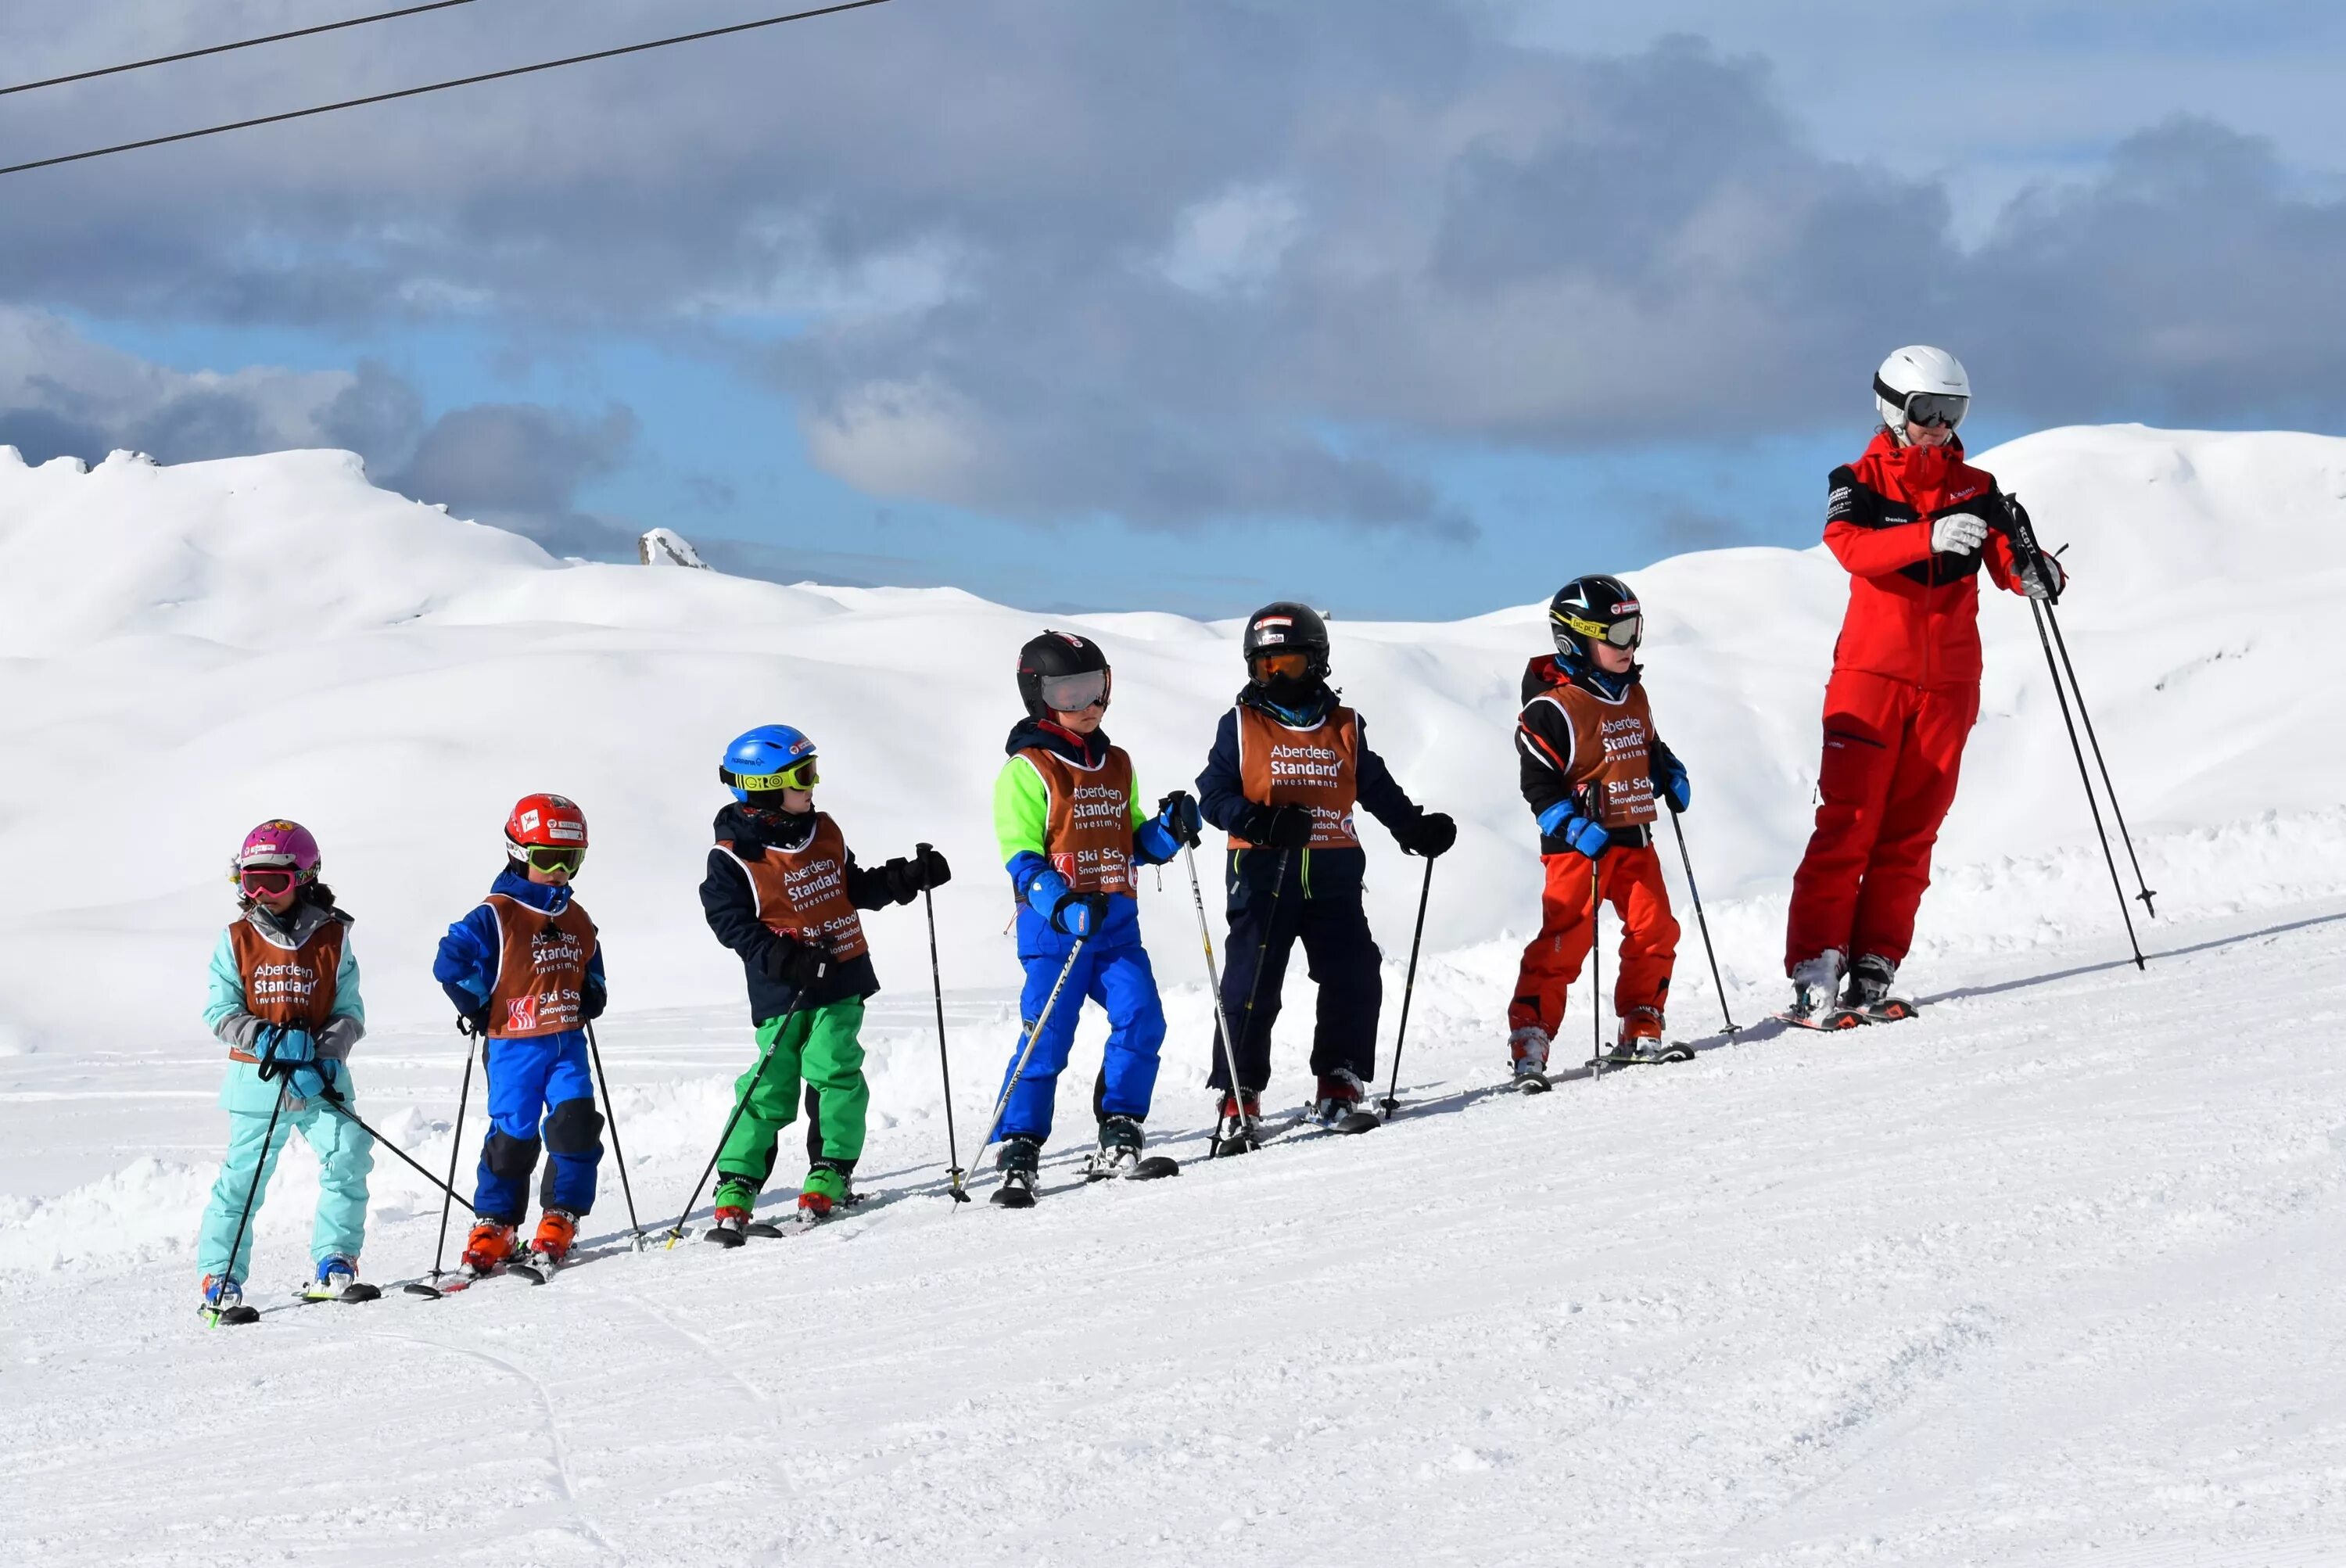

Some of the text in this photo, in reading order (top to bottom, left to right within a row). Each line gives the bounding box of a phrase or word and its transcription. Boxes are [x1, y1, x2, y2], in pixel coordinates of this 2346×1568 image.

[2019, 526, 2036, 554] SCOTT
[1271, 745, 1336, 760] Aberdeen
[1605, 749, 1648, 764] Investme
[1271, 761, 1337, 777] Standard
[1272, 777, 1338, 788] Investments
[1608, 780, 1629, 794] Ski
[1074, 783, 1122, 800] Aberden
[1310, 806, 1340, 820] chool
[1078, 849, 1098, 863] Ski
[794, 888, 844, 913] Investmen
[1193, 881, 1203, 910] LEKI
[802, 910, 858, 938] Ski School
[533, 944, 579, 963] Standrd
[829, 942, 854, 955] losters
[254, 961, 313, 978] Aberdeen
[255, 995, 310, 1006] Investmens
[540, 990, 558, 1004] Ski
